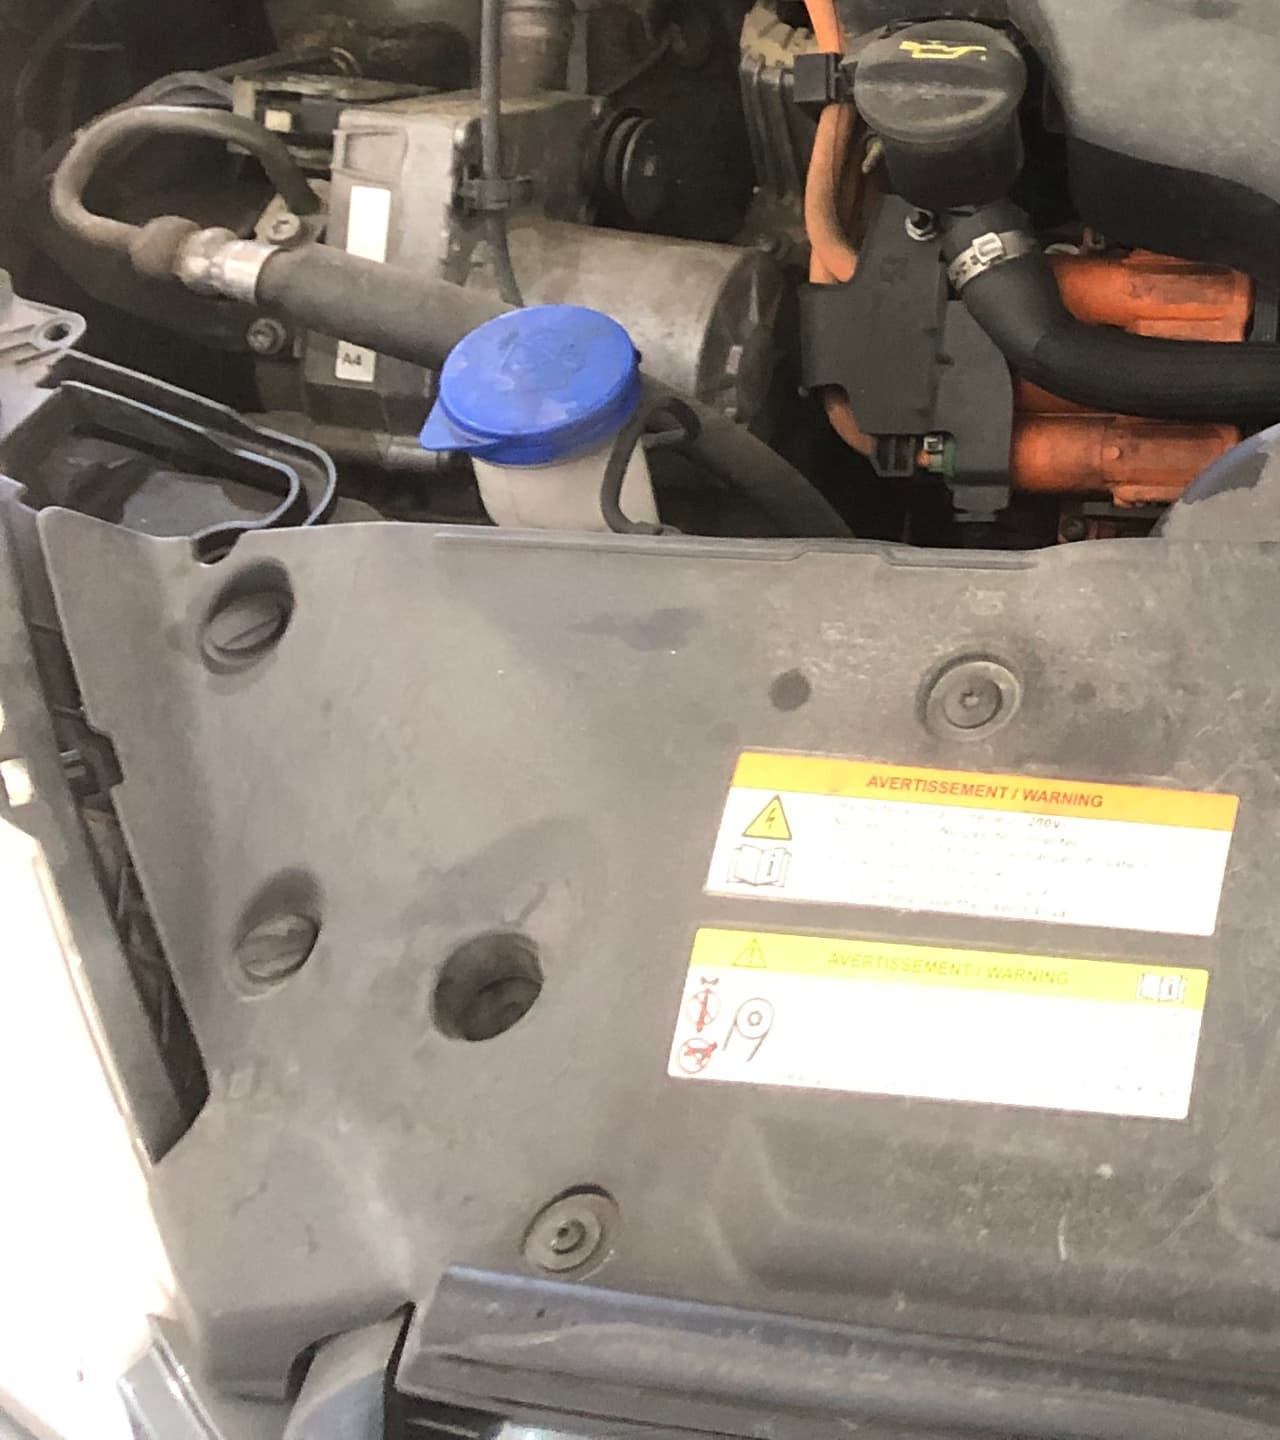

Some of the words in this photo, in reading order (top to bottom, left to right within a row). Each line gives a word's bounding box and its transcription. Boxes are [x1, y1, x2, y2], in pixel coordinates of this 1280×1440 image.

[866, 775, 1008, 800] AVERTISSEMENT
[1022, 789, 1104, 808] WARNING
[828, 951, 973, 977] AVERTISSEMENT
[986, 966, 1070, 986] WARNING
